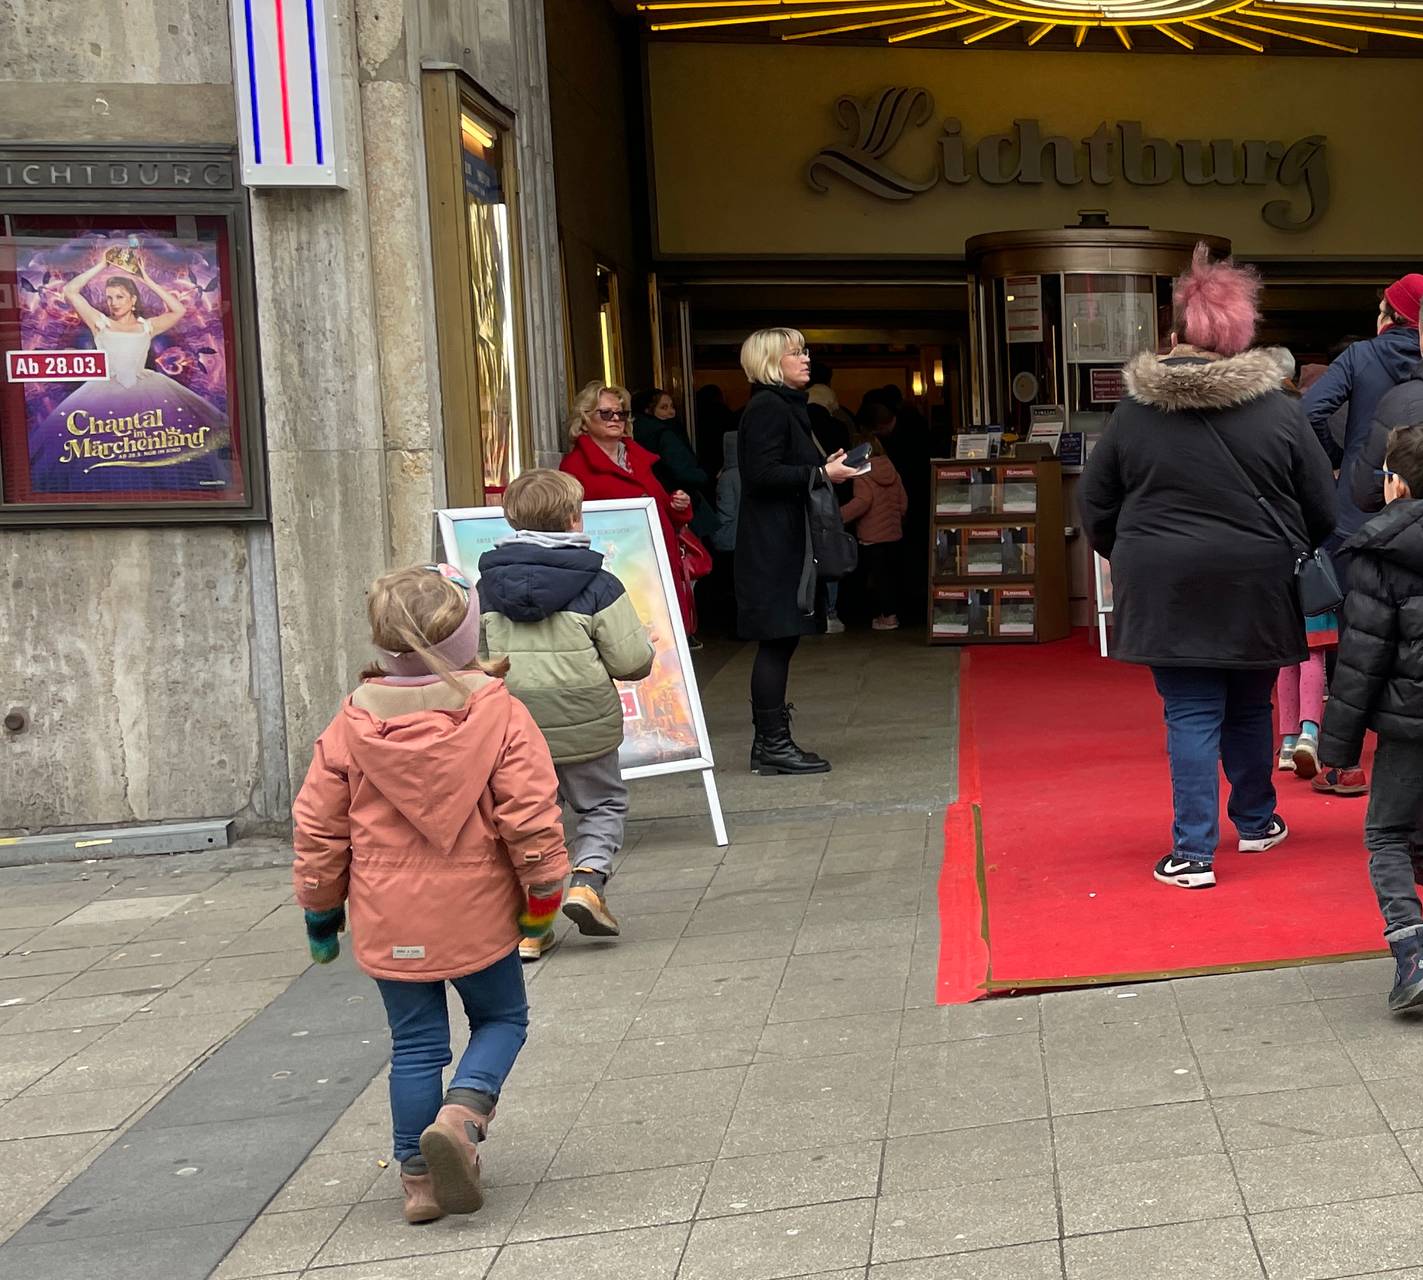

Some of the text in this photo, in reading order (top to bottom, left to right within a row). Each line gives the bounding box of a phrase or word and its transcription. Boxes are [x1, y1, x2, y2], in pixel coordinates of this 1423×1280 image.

[807, 86, 1330, 234] Lichtburg
[16, 356, 102, 375] Ab 28.03.
[66, 408, 164, 437] Chantal
[133, 430, 147, 438] im
[59, 426, 211, 463] Märchenland
